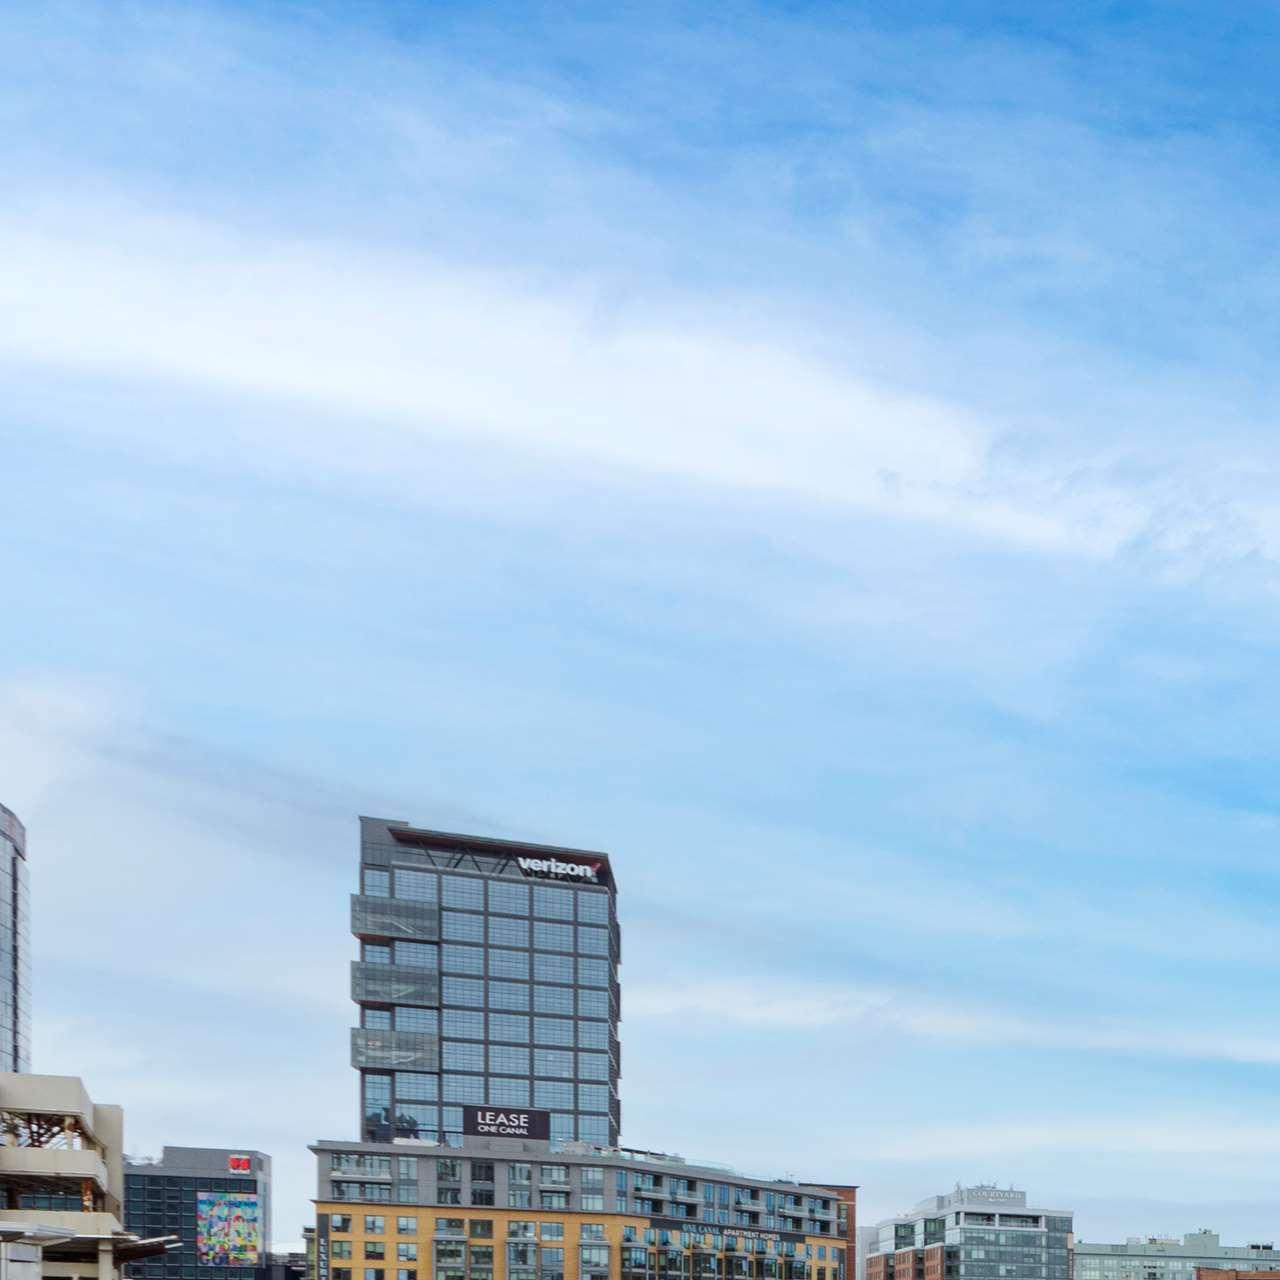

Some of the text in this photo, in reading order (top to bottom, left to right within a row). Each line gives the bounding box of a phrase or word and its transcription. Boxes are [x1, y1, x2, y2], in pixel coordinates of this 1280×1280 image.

[518, 857, 592, 877] verizon
[477, 1111, 529, 1127] LEASE
[478, 1125, 528, 1135] ONE CANAL
